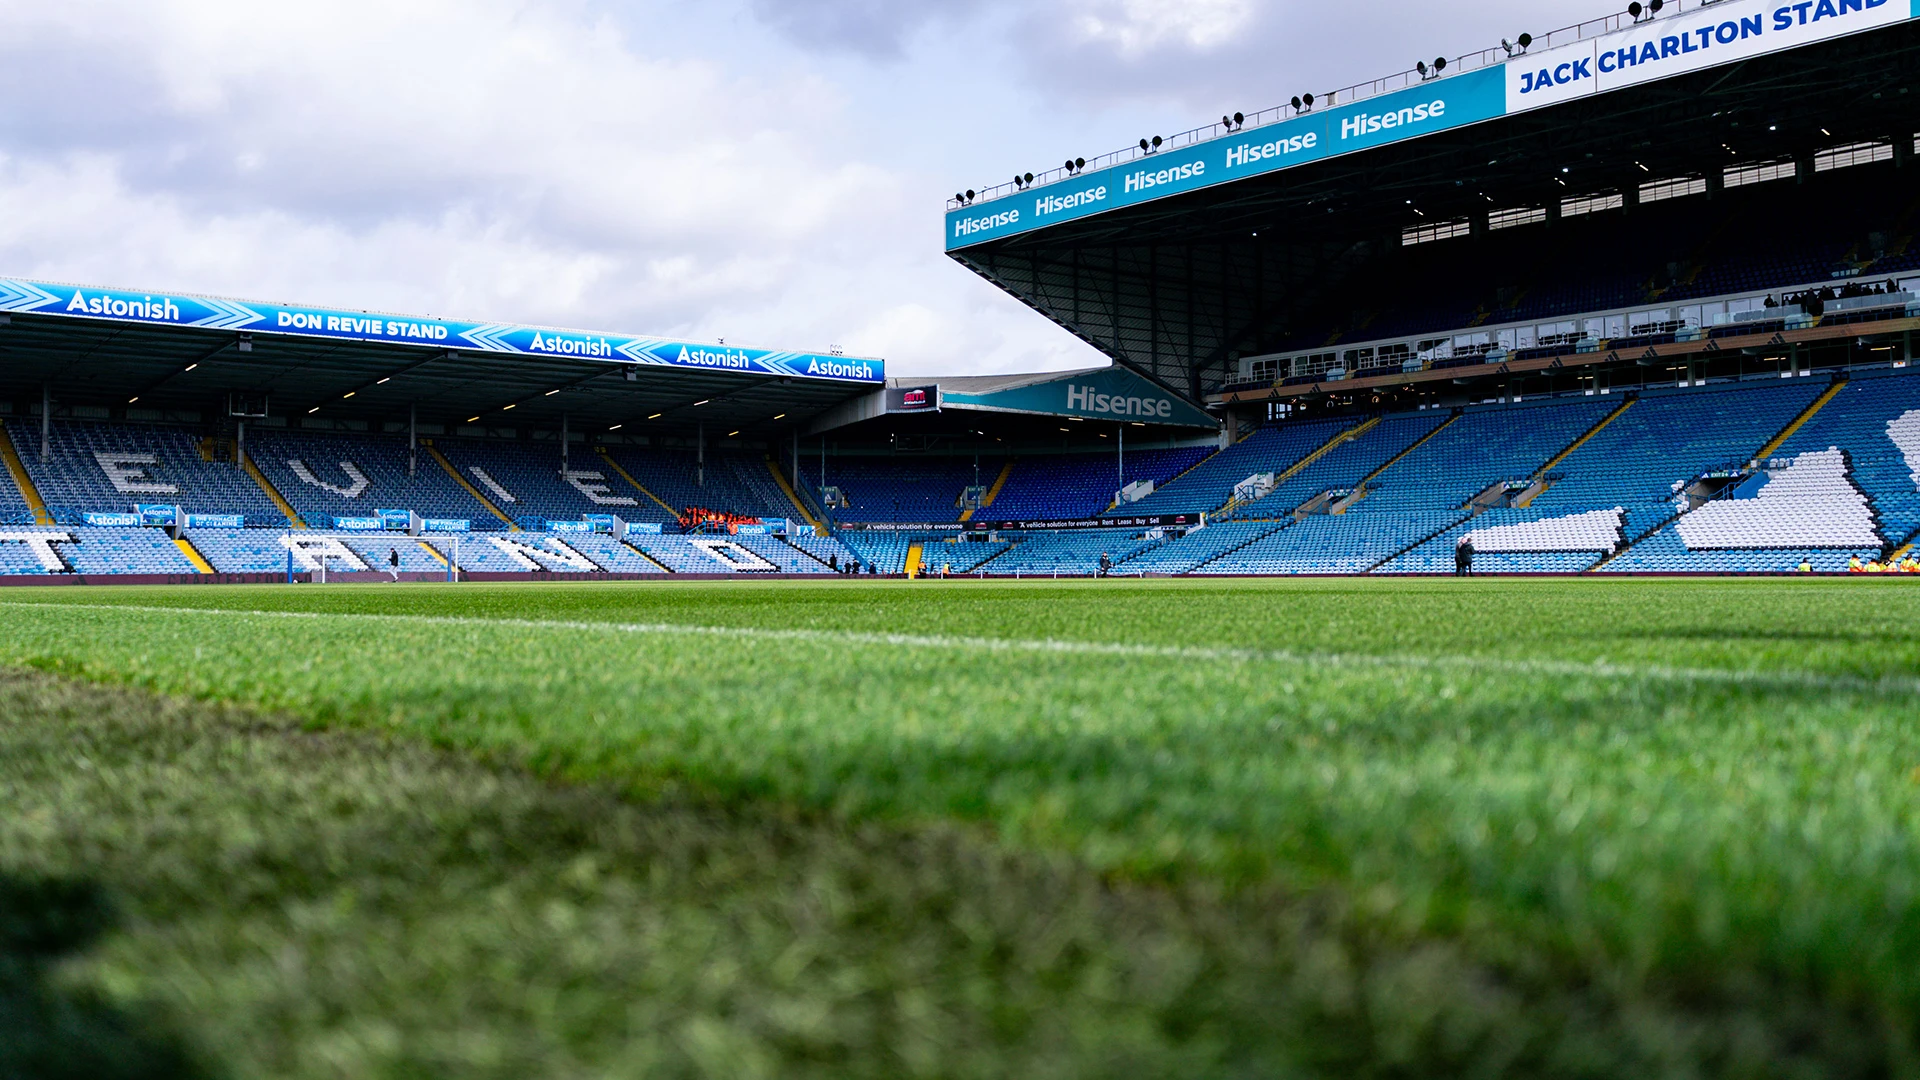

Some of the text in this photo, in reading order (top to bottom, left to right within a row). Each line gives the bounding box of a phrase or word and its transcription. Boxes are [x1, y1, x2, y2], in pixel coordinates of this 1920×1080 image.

[1519, 57, 1592, 94] JACK
[1597, 14, 1763, 73] CHARLTON
[1342, 99, 1445, 140] Hisense
[1227, 131, 1317, 168] Hisense
[1125, 160, 1205, 193] Hisense
[1036, 185, 1107, 217] Hisense
[955, 209, 1020, 237] Hisense
[66, 289, 179, 321] Astonish
[278, 311, 448, 340] DON REVIE STAND
[530, 331, 611, 357] Astonish
[677, 345, 749, 369] Astonish
[808, 357, 873, 379] Astonish
[1067, 384, 1172, 417] Hisense
[88, 515, 138, 526] Astonish
[143, 508, 173, 517] Astonish
[338, 518, 381, 530] Astonish
[1047, 520, 1067, 528] solution
[1076, 520, 1098, 528] everyone
[1117, 518, 1132, 526] Lease
[1135, 517, 1146, 526] Buy
[553, 522, 589, 532] Astonish
[738, 524, 766, 534] stonish
